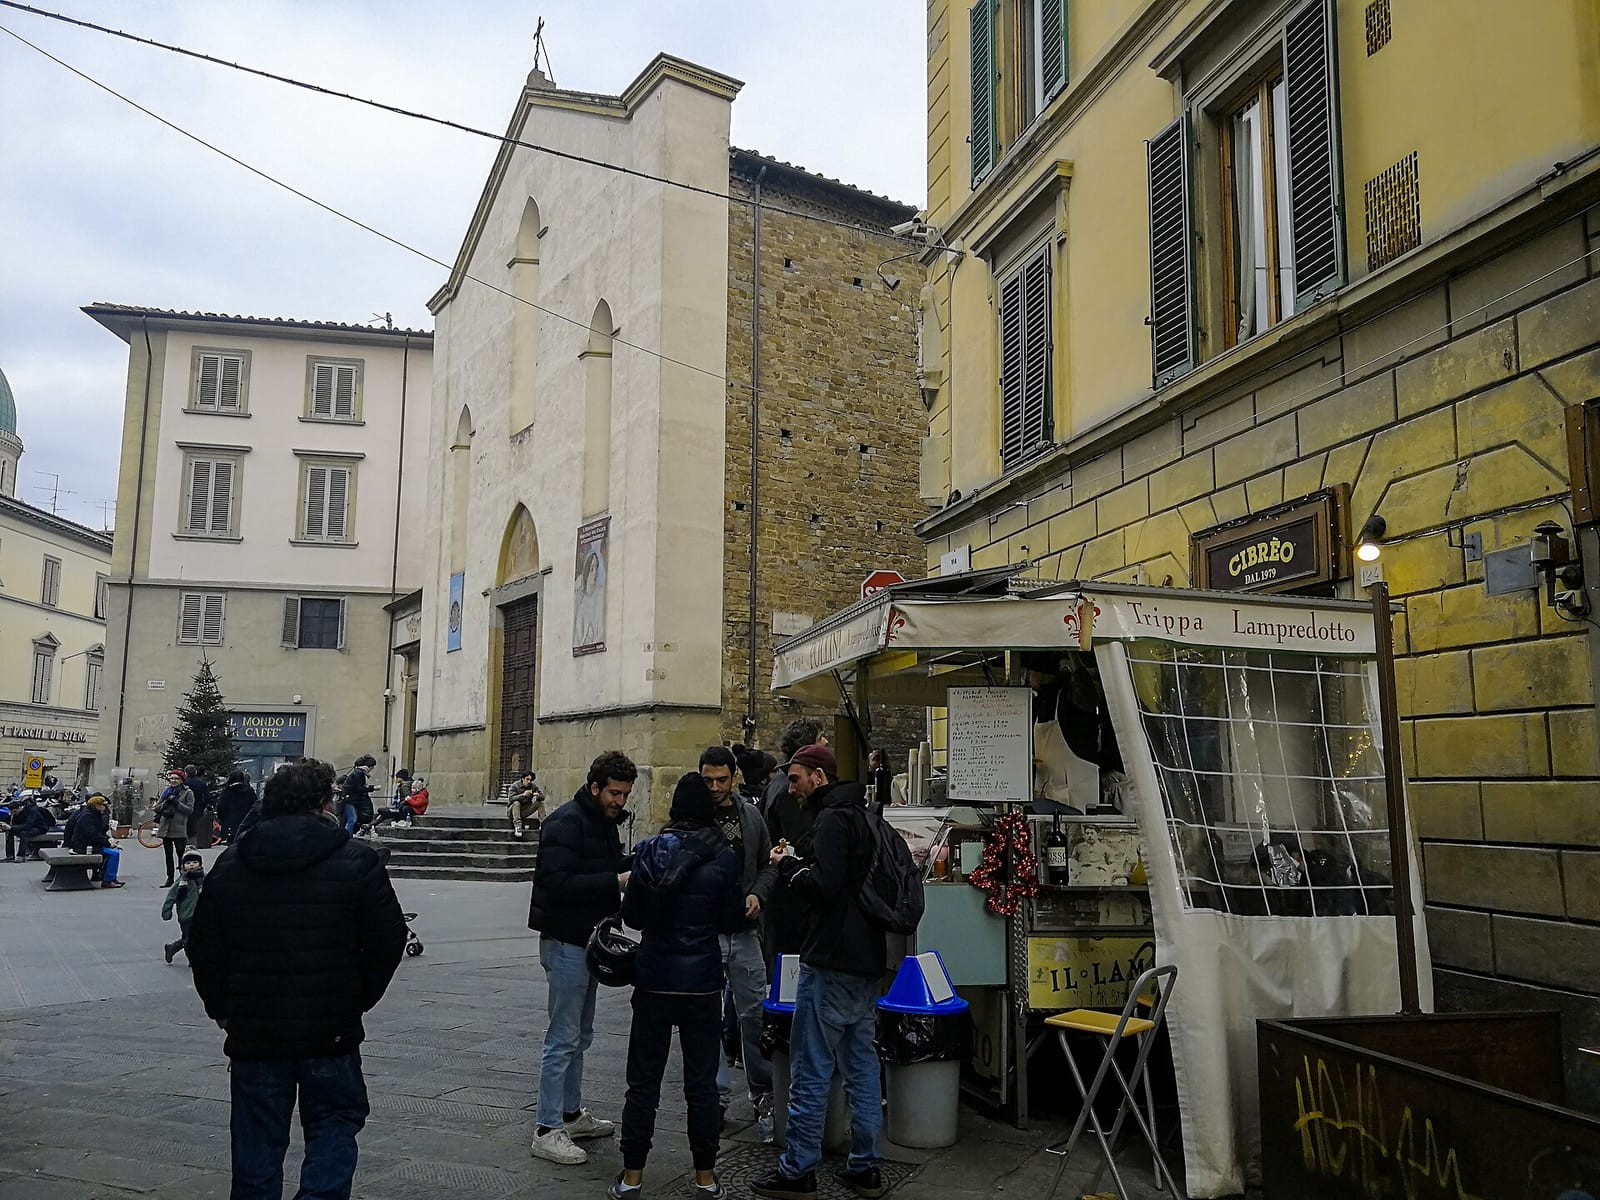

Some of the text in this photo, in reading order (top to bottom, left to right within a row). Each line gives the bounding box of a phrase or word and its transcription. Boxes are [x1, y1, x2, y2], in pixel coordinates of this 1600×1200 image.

[1244, 567, 1277, 585] DAL 1979
[1127, 602, 1356, 645] Trippa Lampredotto
[242, 716, 285, 727] MONDO
[288, 716, 301, 727] IN
[13, 726, 46, 740] PASCHI
[50, 729, 61, 740] DI
[1050, 967, 1078, 992] IL
